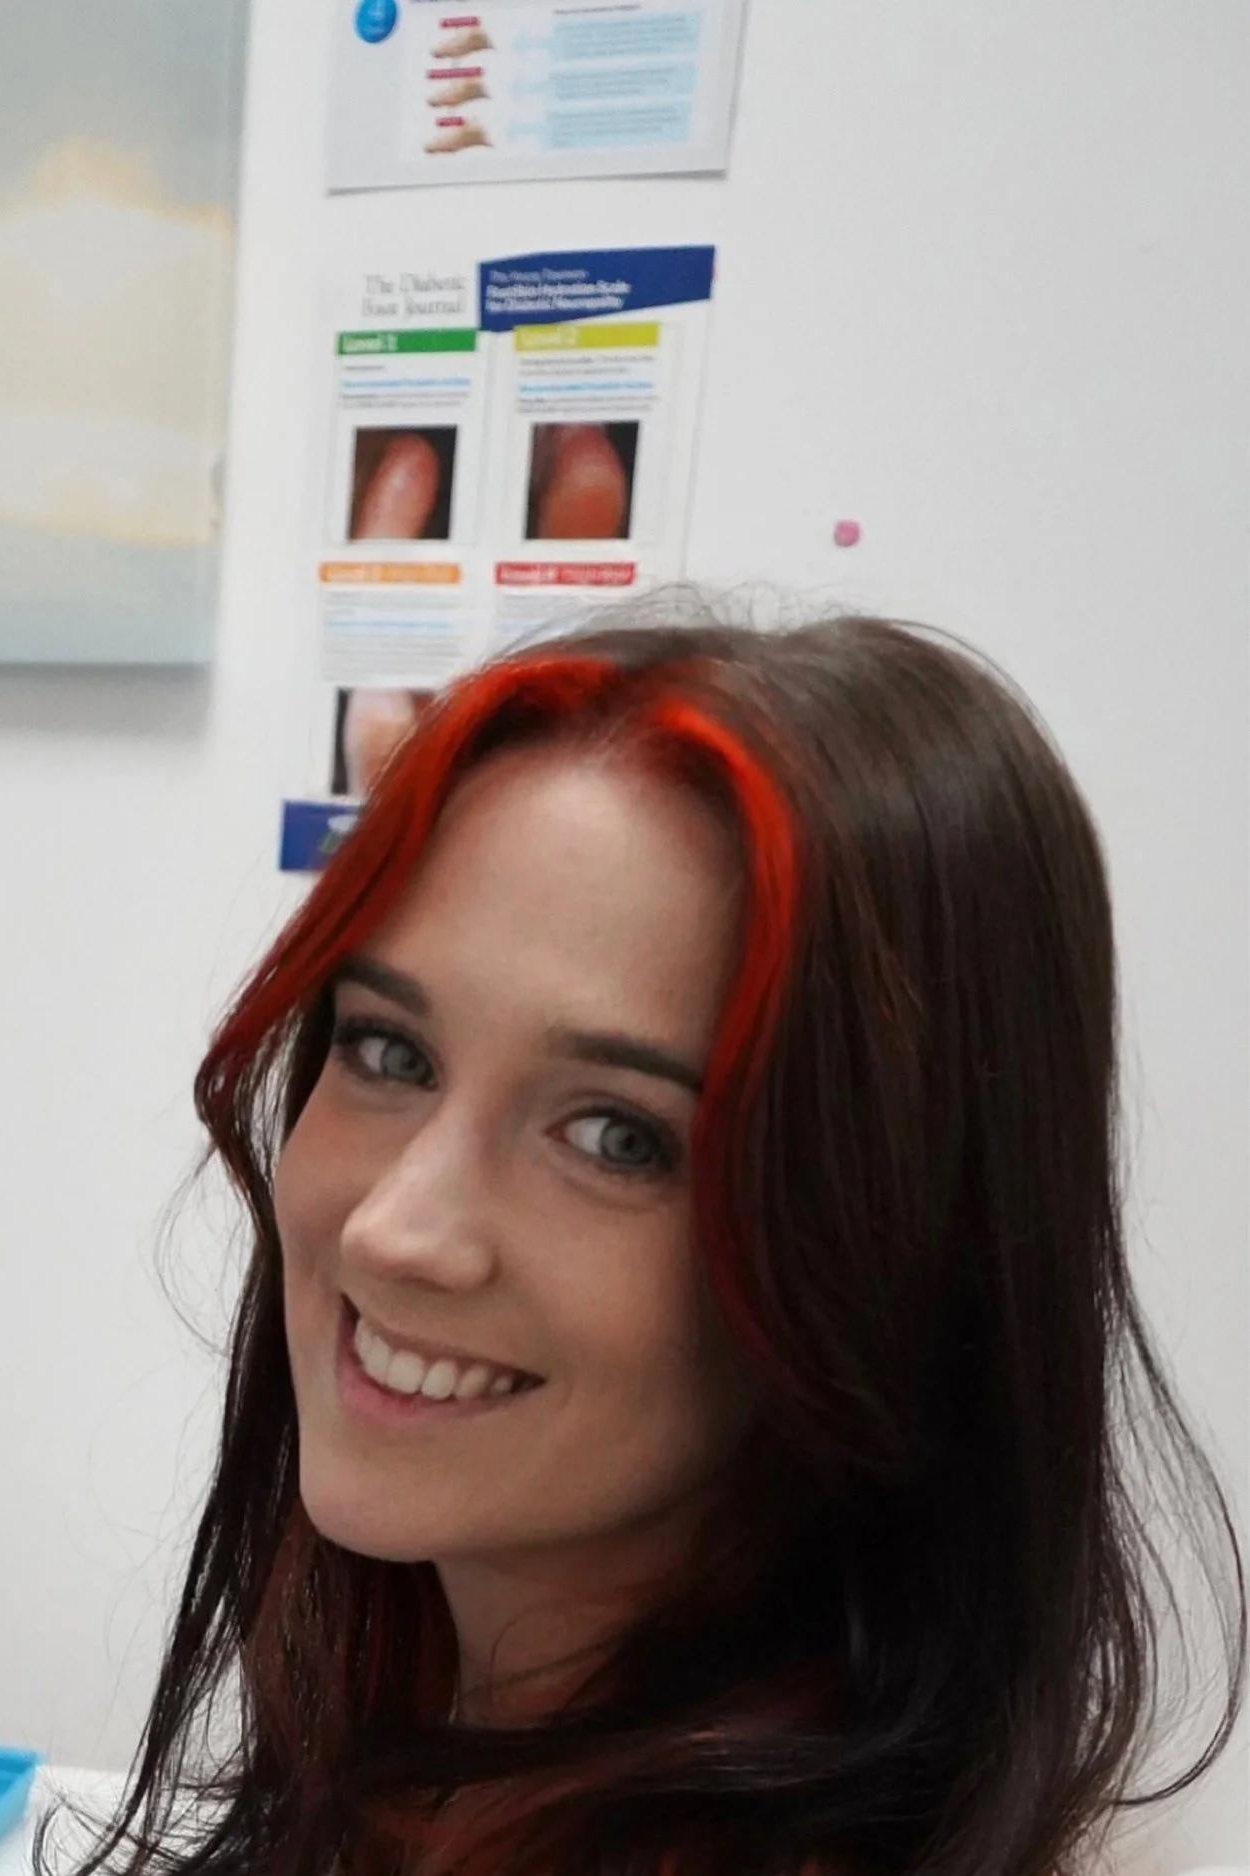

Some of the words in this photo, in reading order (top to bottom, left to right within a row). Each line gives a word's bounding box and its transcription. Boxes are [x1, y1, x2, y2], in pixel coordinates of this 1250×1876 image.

[363, 274, 395, 294] The
[400, 270, 467, 292] Diabetic
[402, 294, 463, 319] Journal
